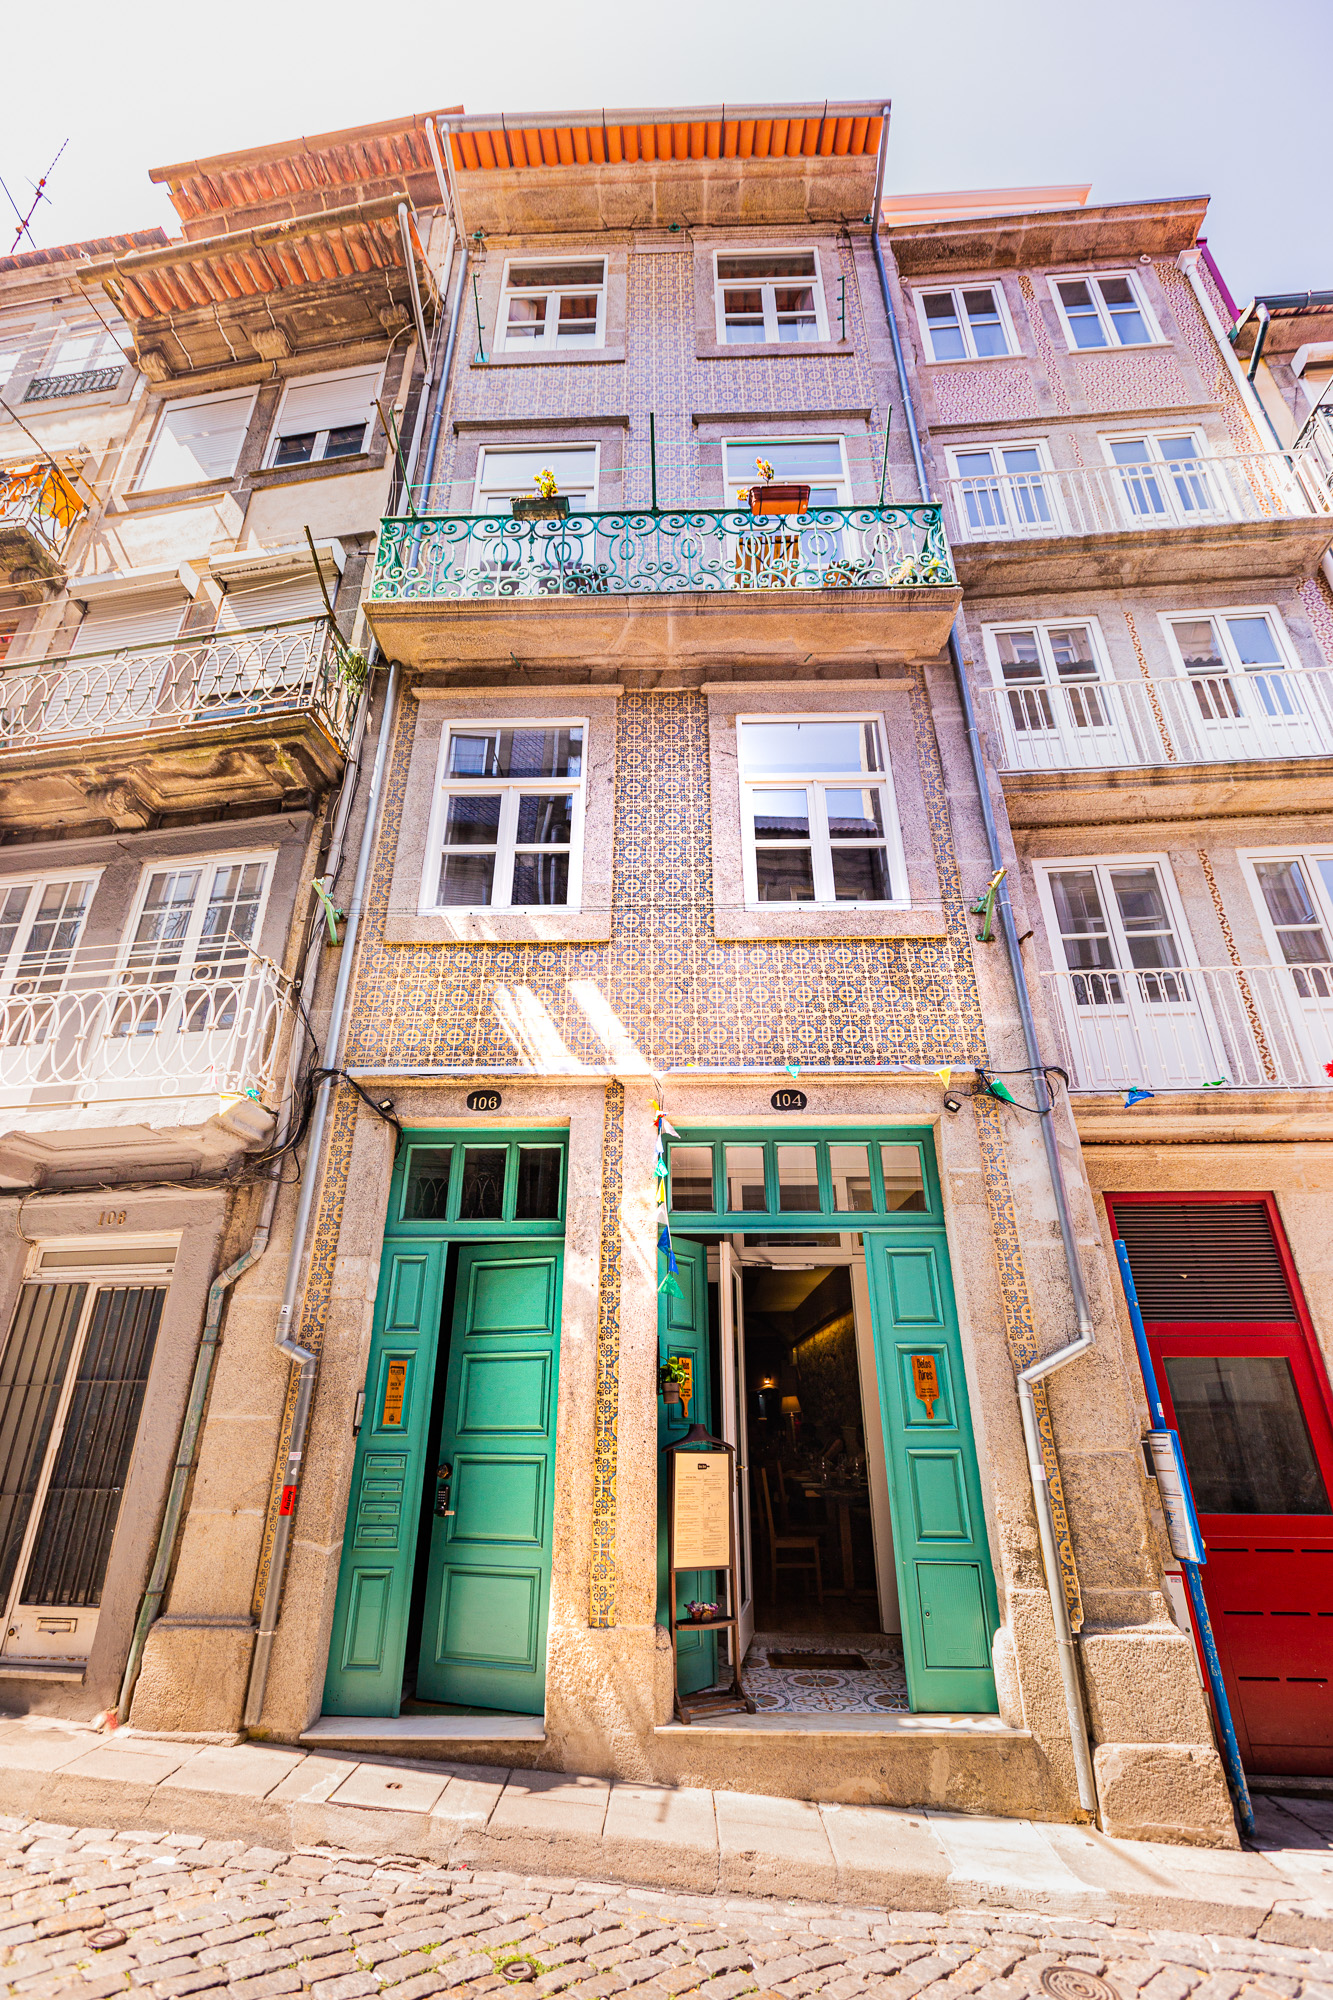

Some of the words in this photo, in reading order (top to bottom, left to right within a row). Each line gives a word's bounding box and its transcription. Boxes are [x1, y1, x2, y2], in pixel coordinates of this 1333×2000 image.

[472, 1096, 498, 1110] 106
[775, 1093, 803, 1107] 104
[97, 1210, 127, 1226] 108
